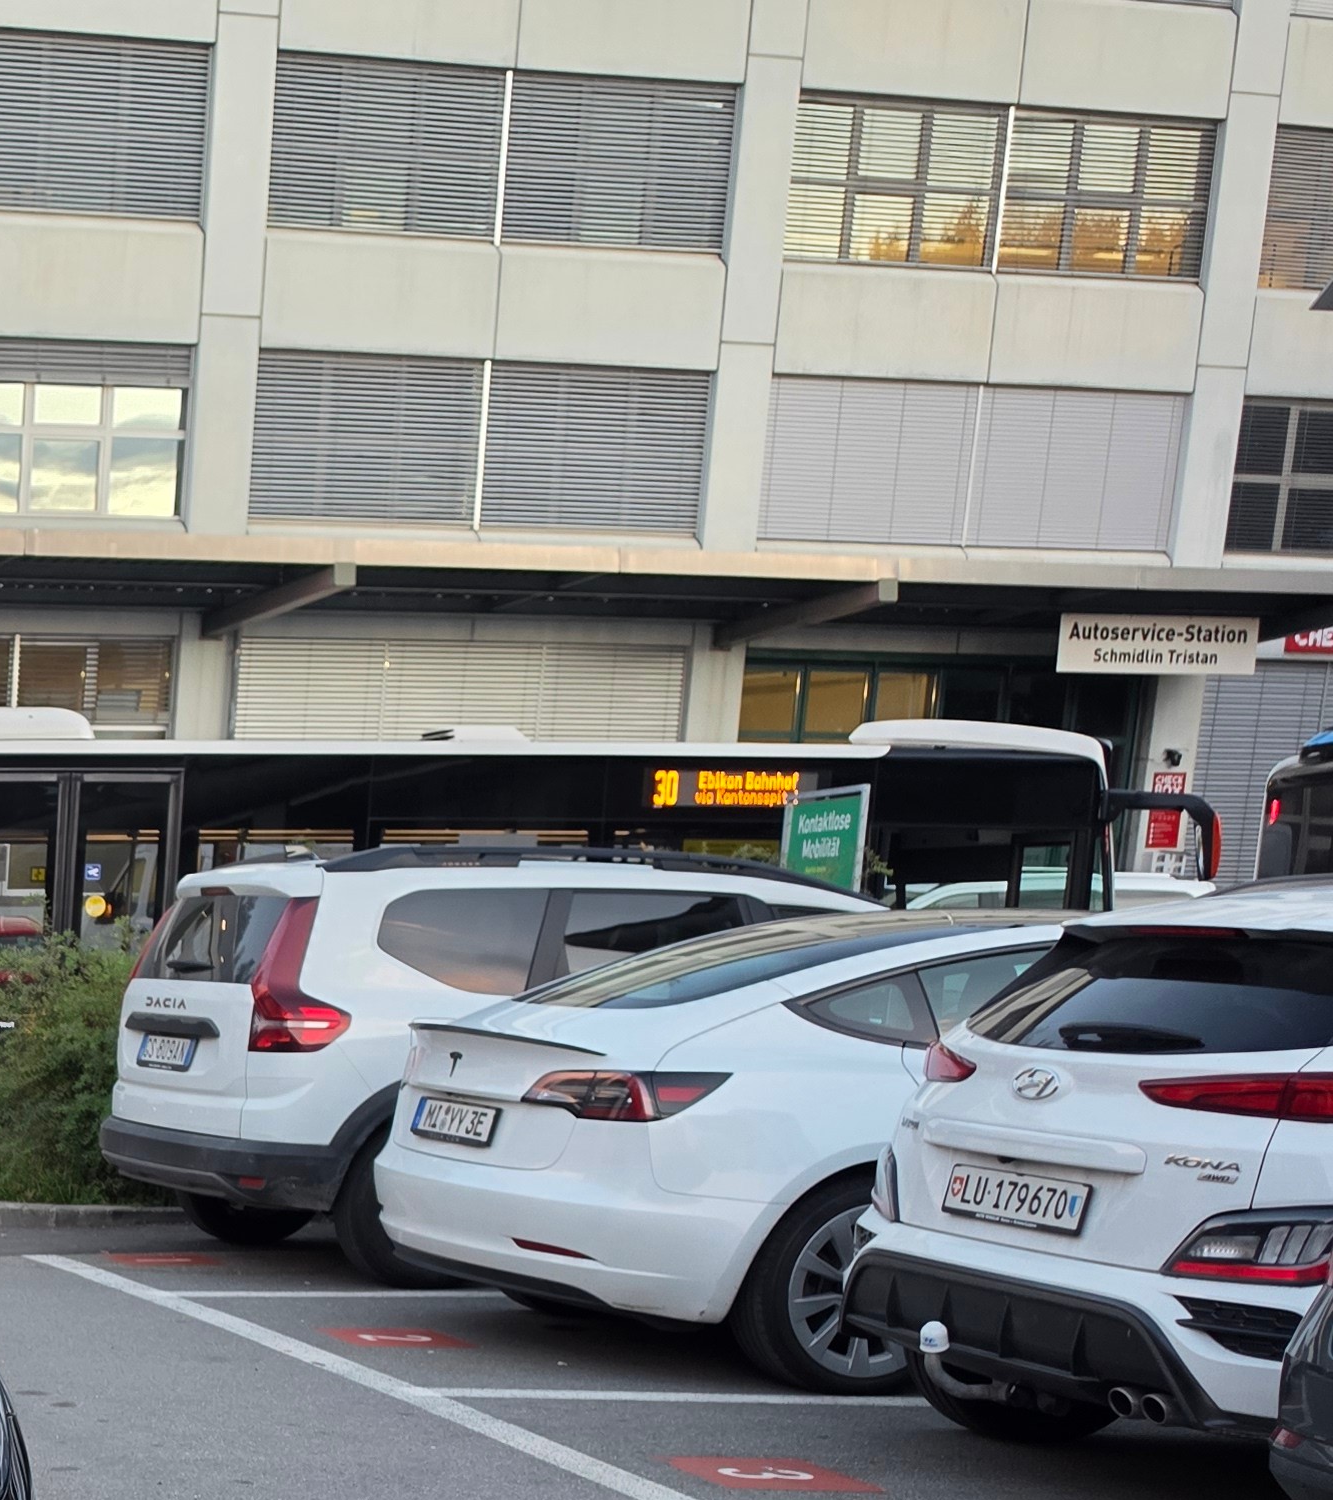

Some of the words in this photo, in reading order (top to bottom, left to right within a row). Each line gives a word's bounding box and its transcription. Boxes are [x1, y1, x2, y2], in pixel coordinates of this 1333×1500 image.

[1068, 621, 1249, 644] Autoservice-Station
[1093, 648, 1163, 664] Schmidlin
[1167, 649, 1219, 665] Tristan
[653, 769, 679, 805] 30
[698, 770, 743, 790] Ebikon
[745, 771, 800, 791] Bahnhof
[694, 789, 714, 805] via
[798, 810, 852, 834] Kontaktlose
[802, 836, 840, 859] Mobilität
[145, 996, 187, 1010] DACIA
[1164, 1154, 1241, 1173] KONA
